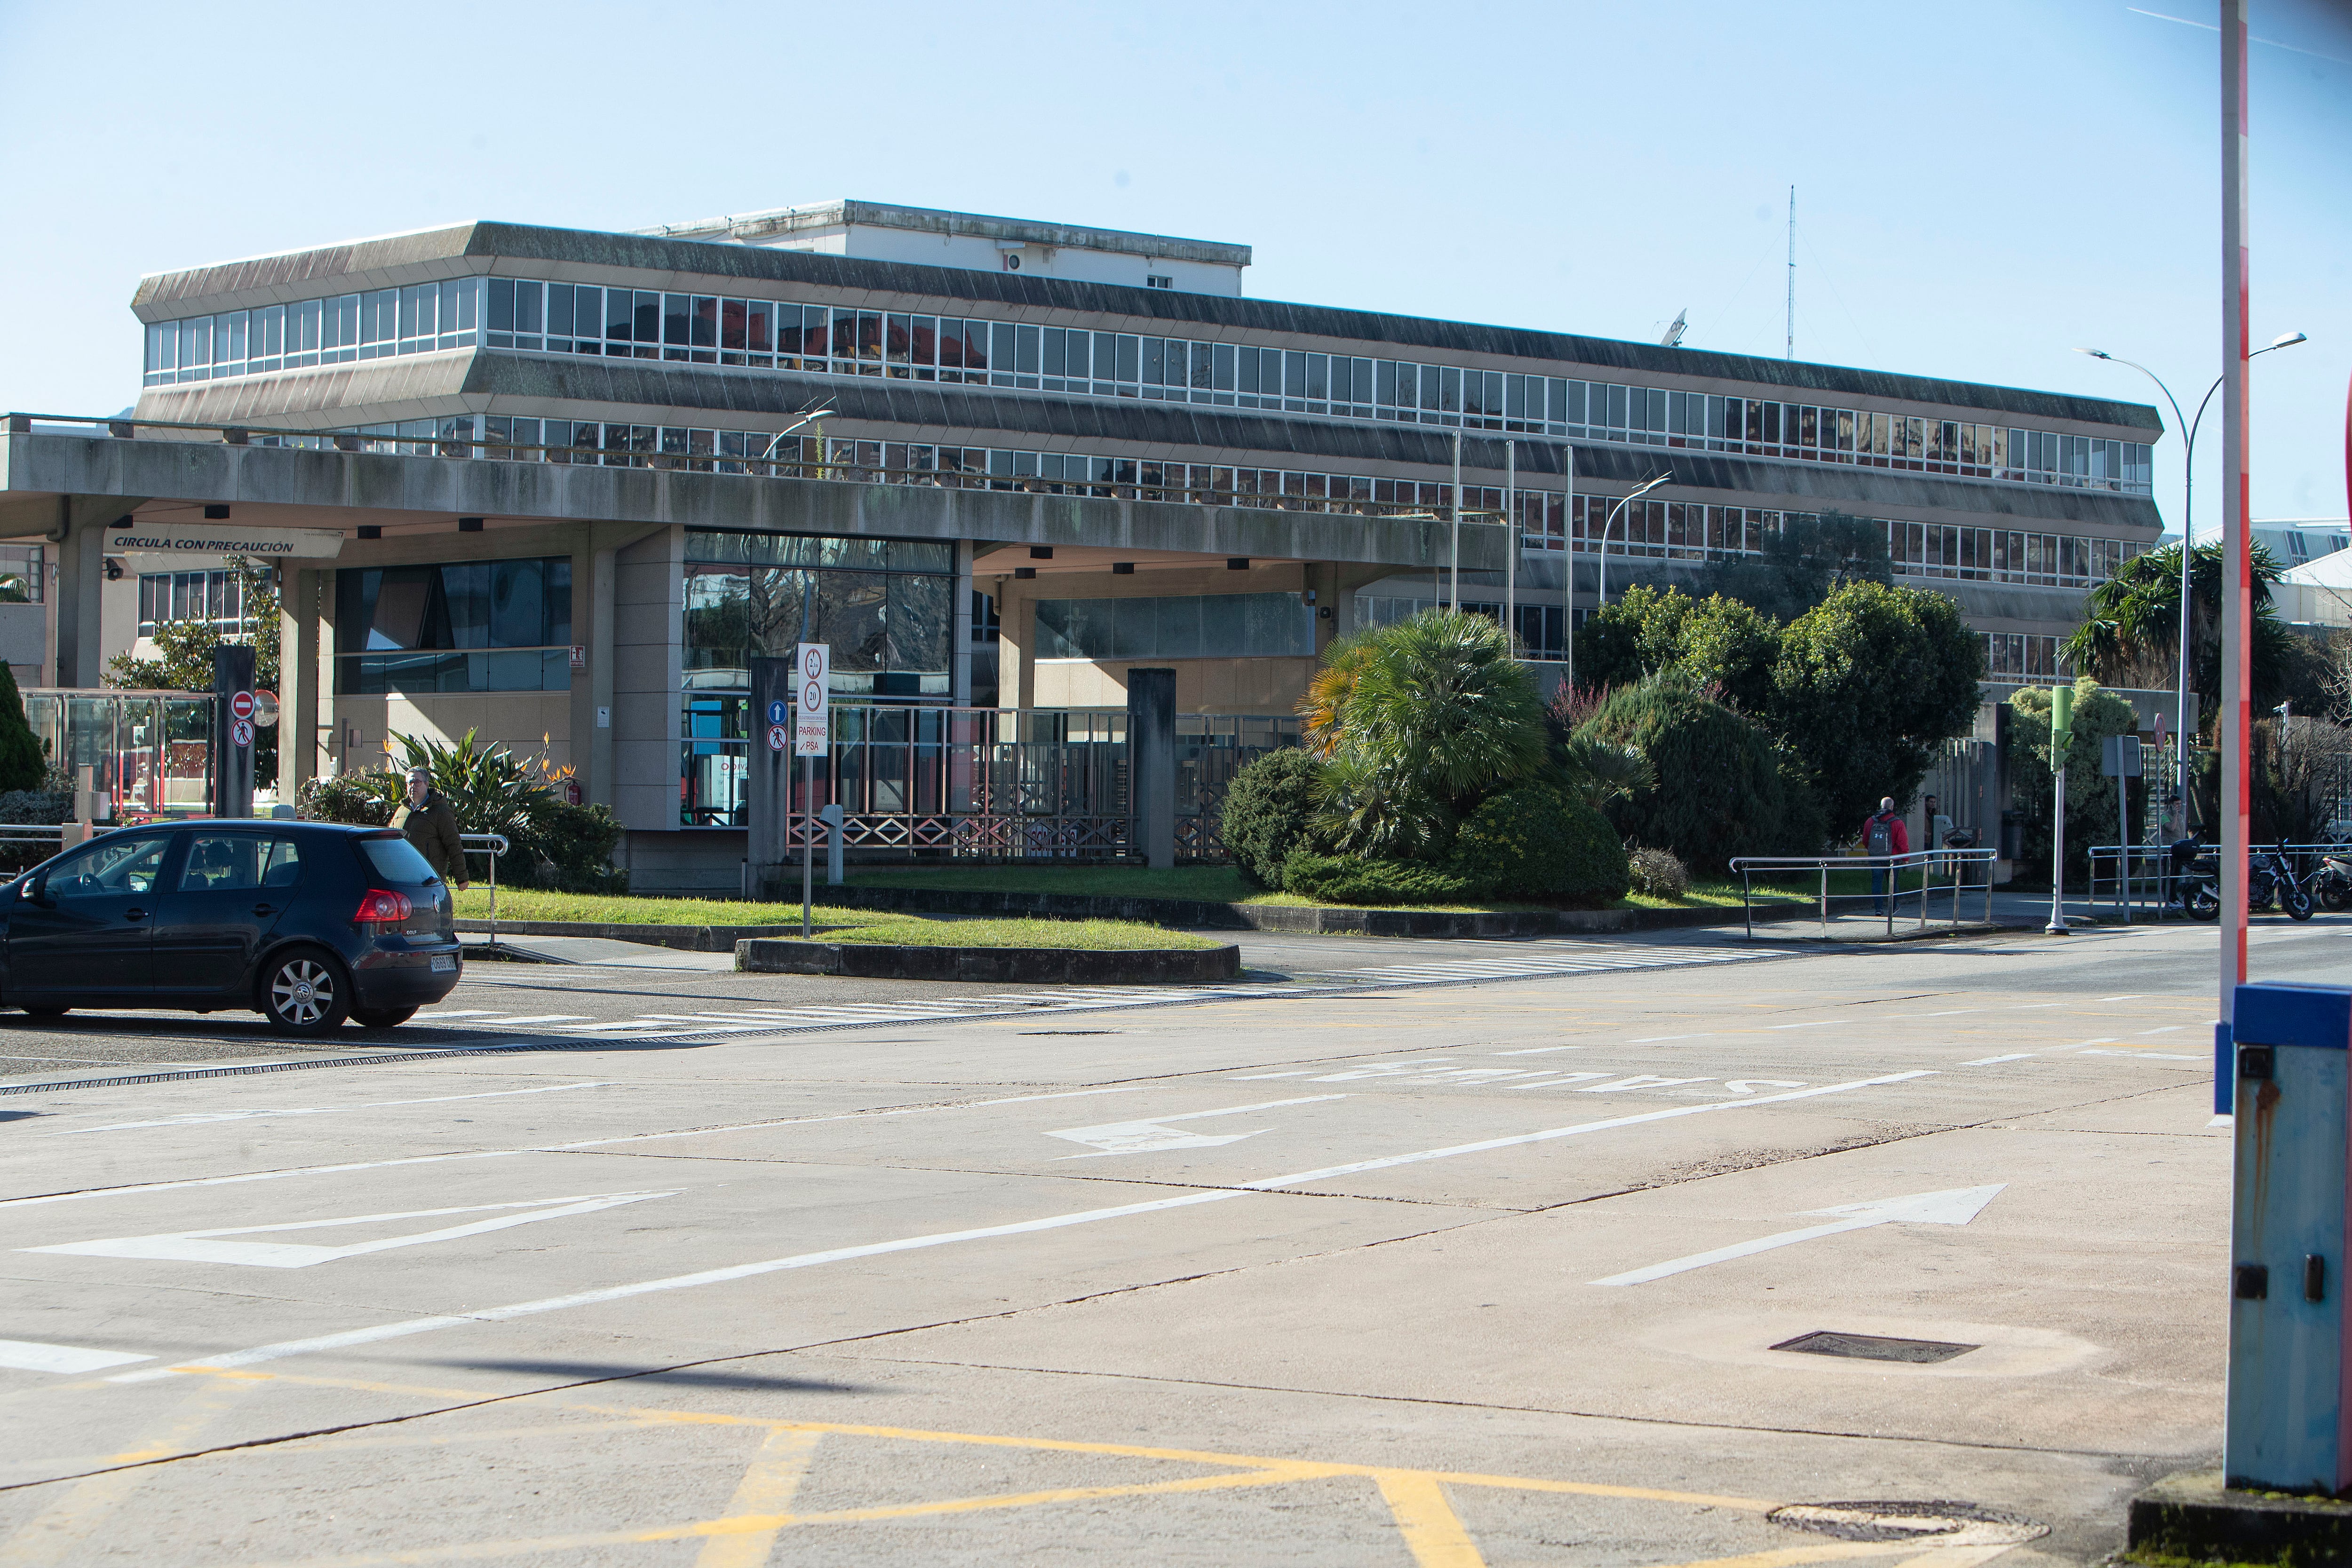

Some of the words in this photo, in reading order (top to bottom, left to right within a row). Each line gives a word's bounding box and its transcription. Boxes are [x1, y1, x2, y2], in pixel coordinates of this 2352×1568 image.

[114, 537, 171, 548] CIRCULA
[175, 540, 206, 549] CON
[207, 541, 294, 552] PRECAUCIÓN
[810, 692, 816, 700] 20
[799, 726, 826, 736] PARKING
[806, 741, 818, 750] PSA
[433, 957, 446, 969] 0669
